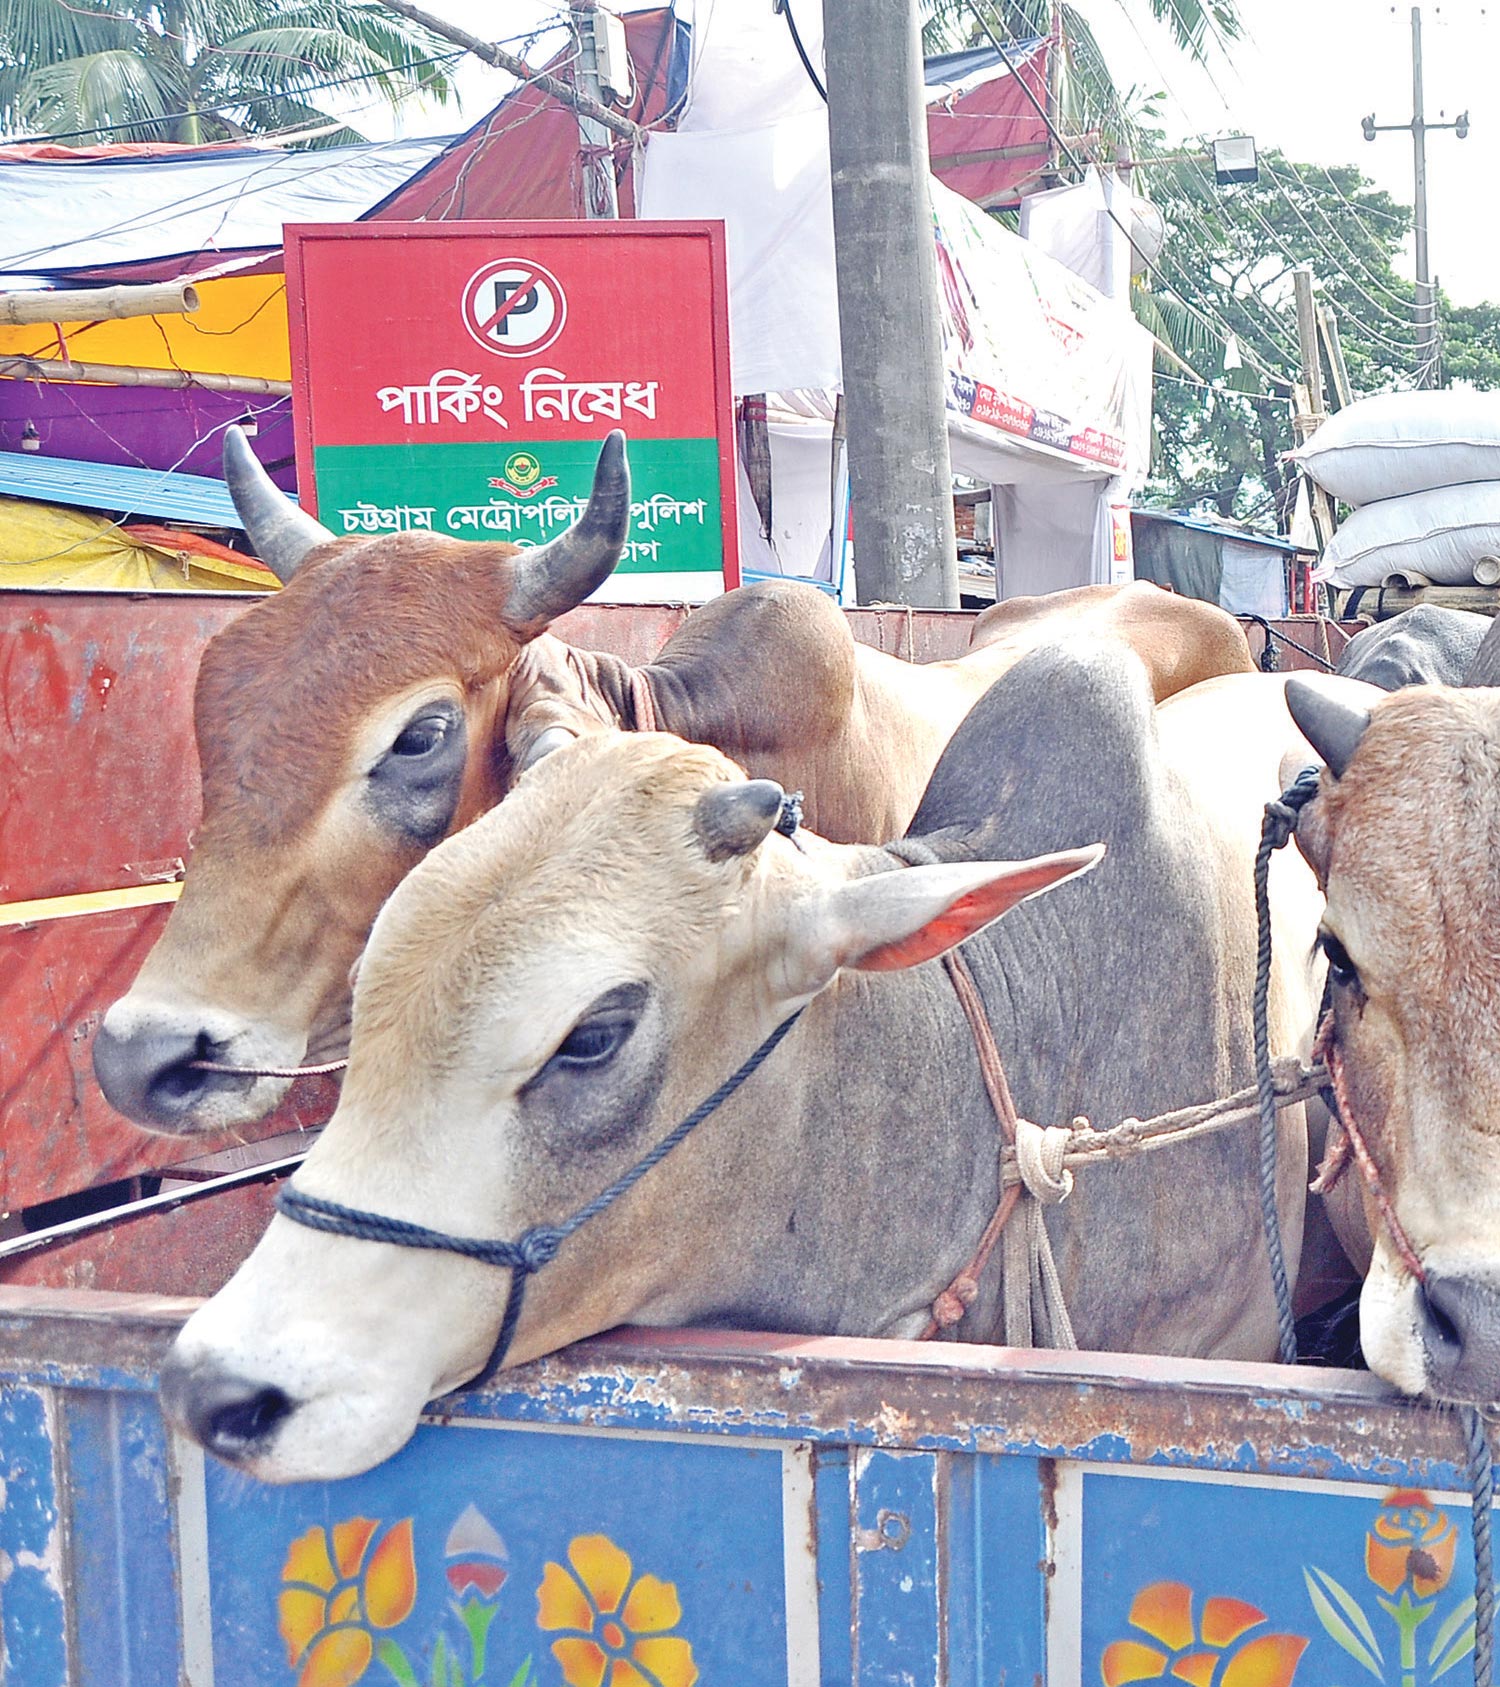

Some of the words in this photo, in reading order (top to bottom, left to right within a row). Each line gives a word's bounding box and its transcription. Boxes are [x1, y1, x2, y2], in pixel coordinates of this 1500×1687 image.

[494, 281, 538, 335] P
[376, 369, 509, 429] পার্কিং
[520, 367, 659, 423] নিষেধ
[338, 501, 435, 534] চট্টগ্রাম
[629, 493, 706, 532] পুলিশ
